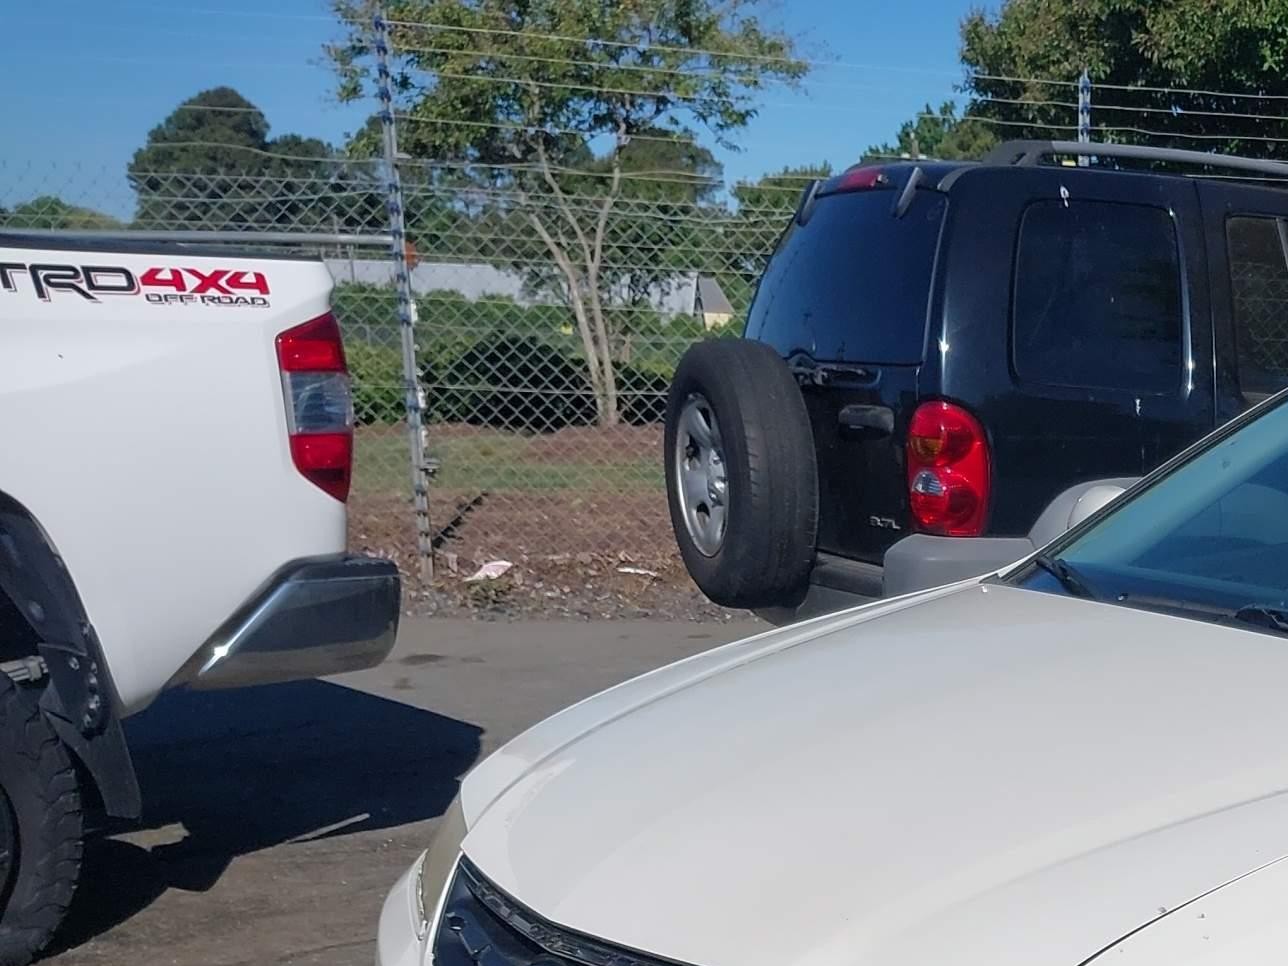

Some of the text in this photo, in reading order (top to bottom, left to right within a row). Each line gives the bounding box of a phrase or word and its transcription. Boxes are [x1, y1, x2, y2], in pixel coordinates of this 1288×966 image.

[0, 262, 140, 303] TRD
[145, 293, 270, 308] OFF ROAD
